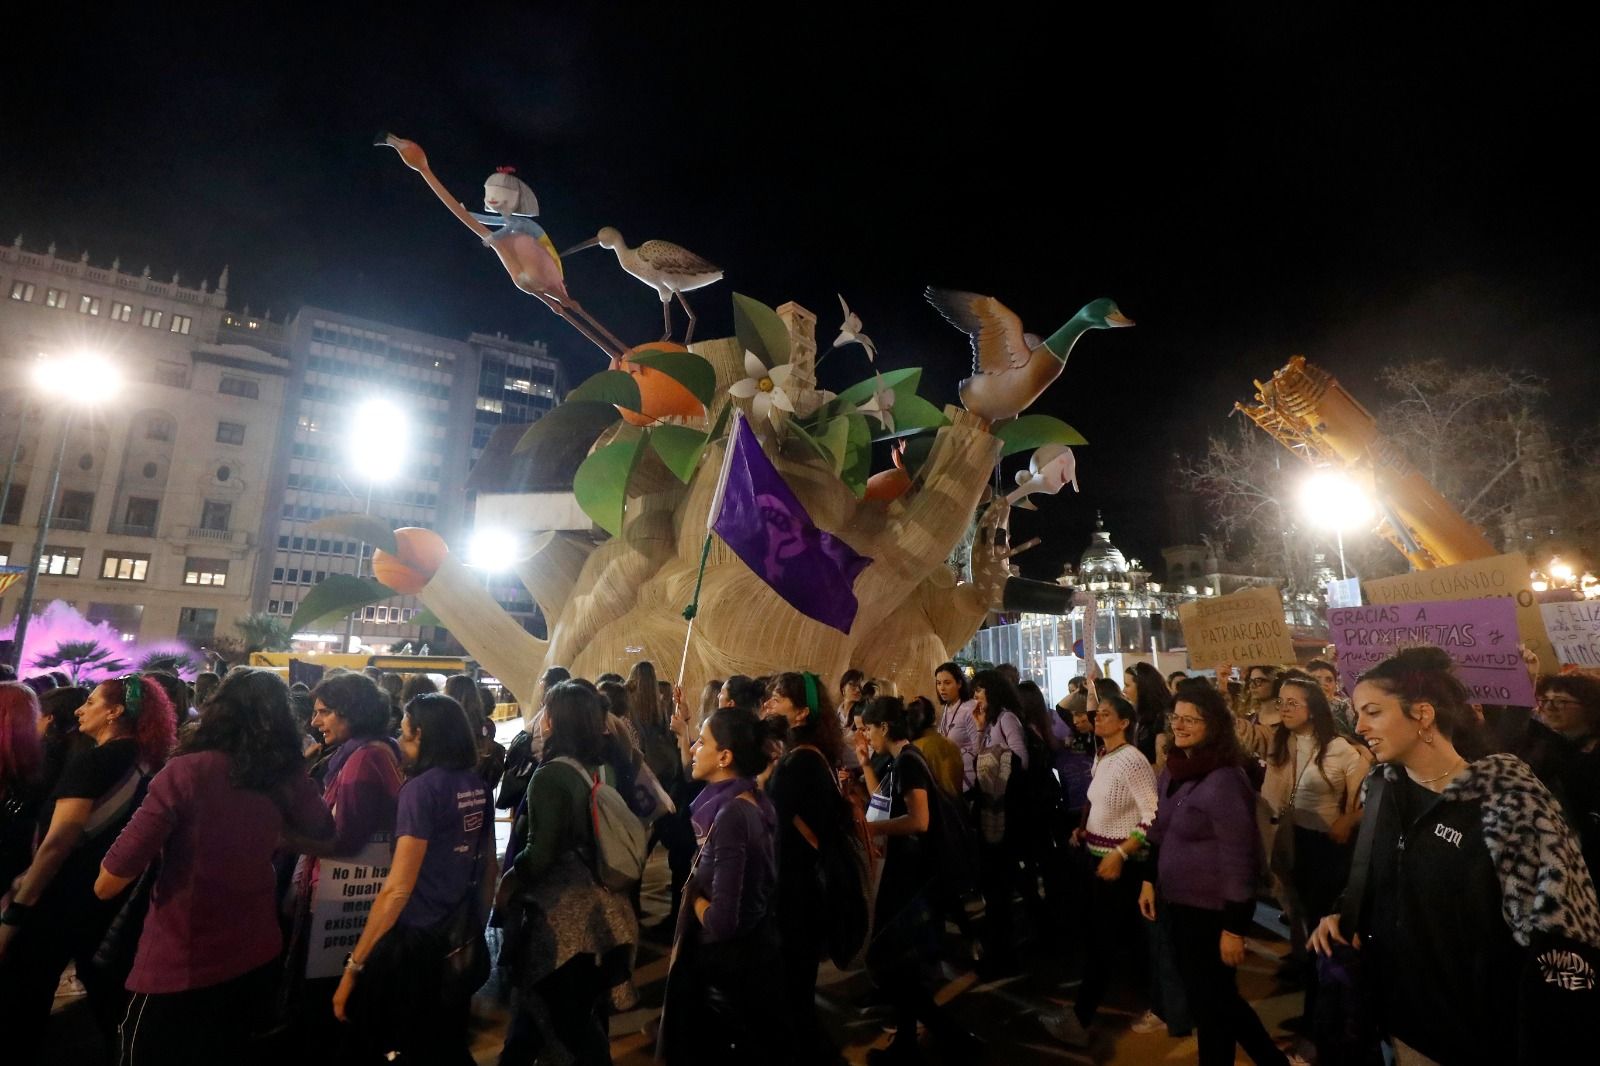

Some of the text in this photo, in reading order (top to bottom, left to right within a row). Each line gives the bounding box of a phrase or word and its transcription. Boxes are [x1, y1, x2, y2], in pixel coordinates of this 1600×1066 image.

[1331, 606, 1426, 626] GRACIAS A
[1200, 620, 1281, 645] PATRIARCADO
[1343, 624, 1476, 648] PROXENETAS
[1468, 685, 1511, 700] ARRIO
[332, 867, 350, 880] No
[354, 866, 367, 879] hi
[342, 882, 382, 897] Igualt
[343, 900, 372, 912] men
